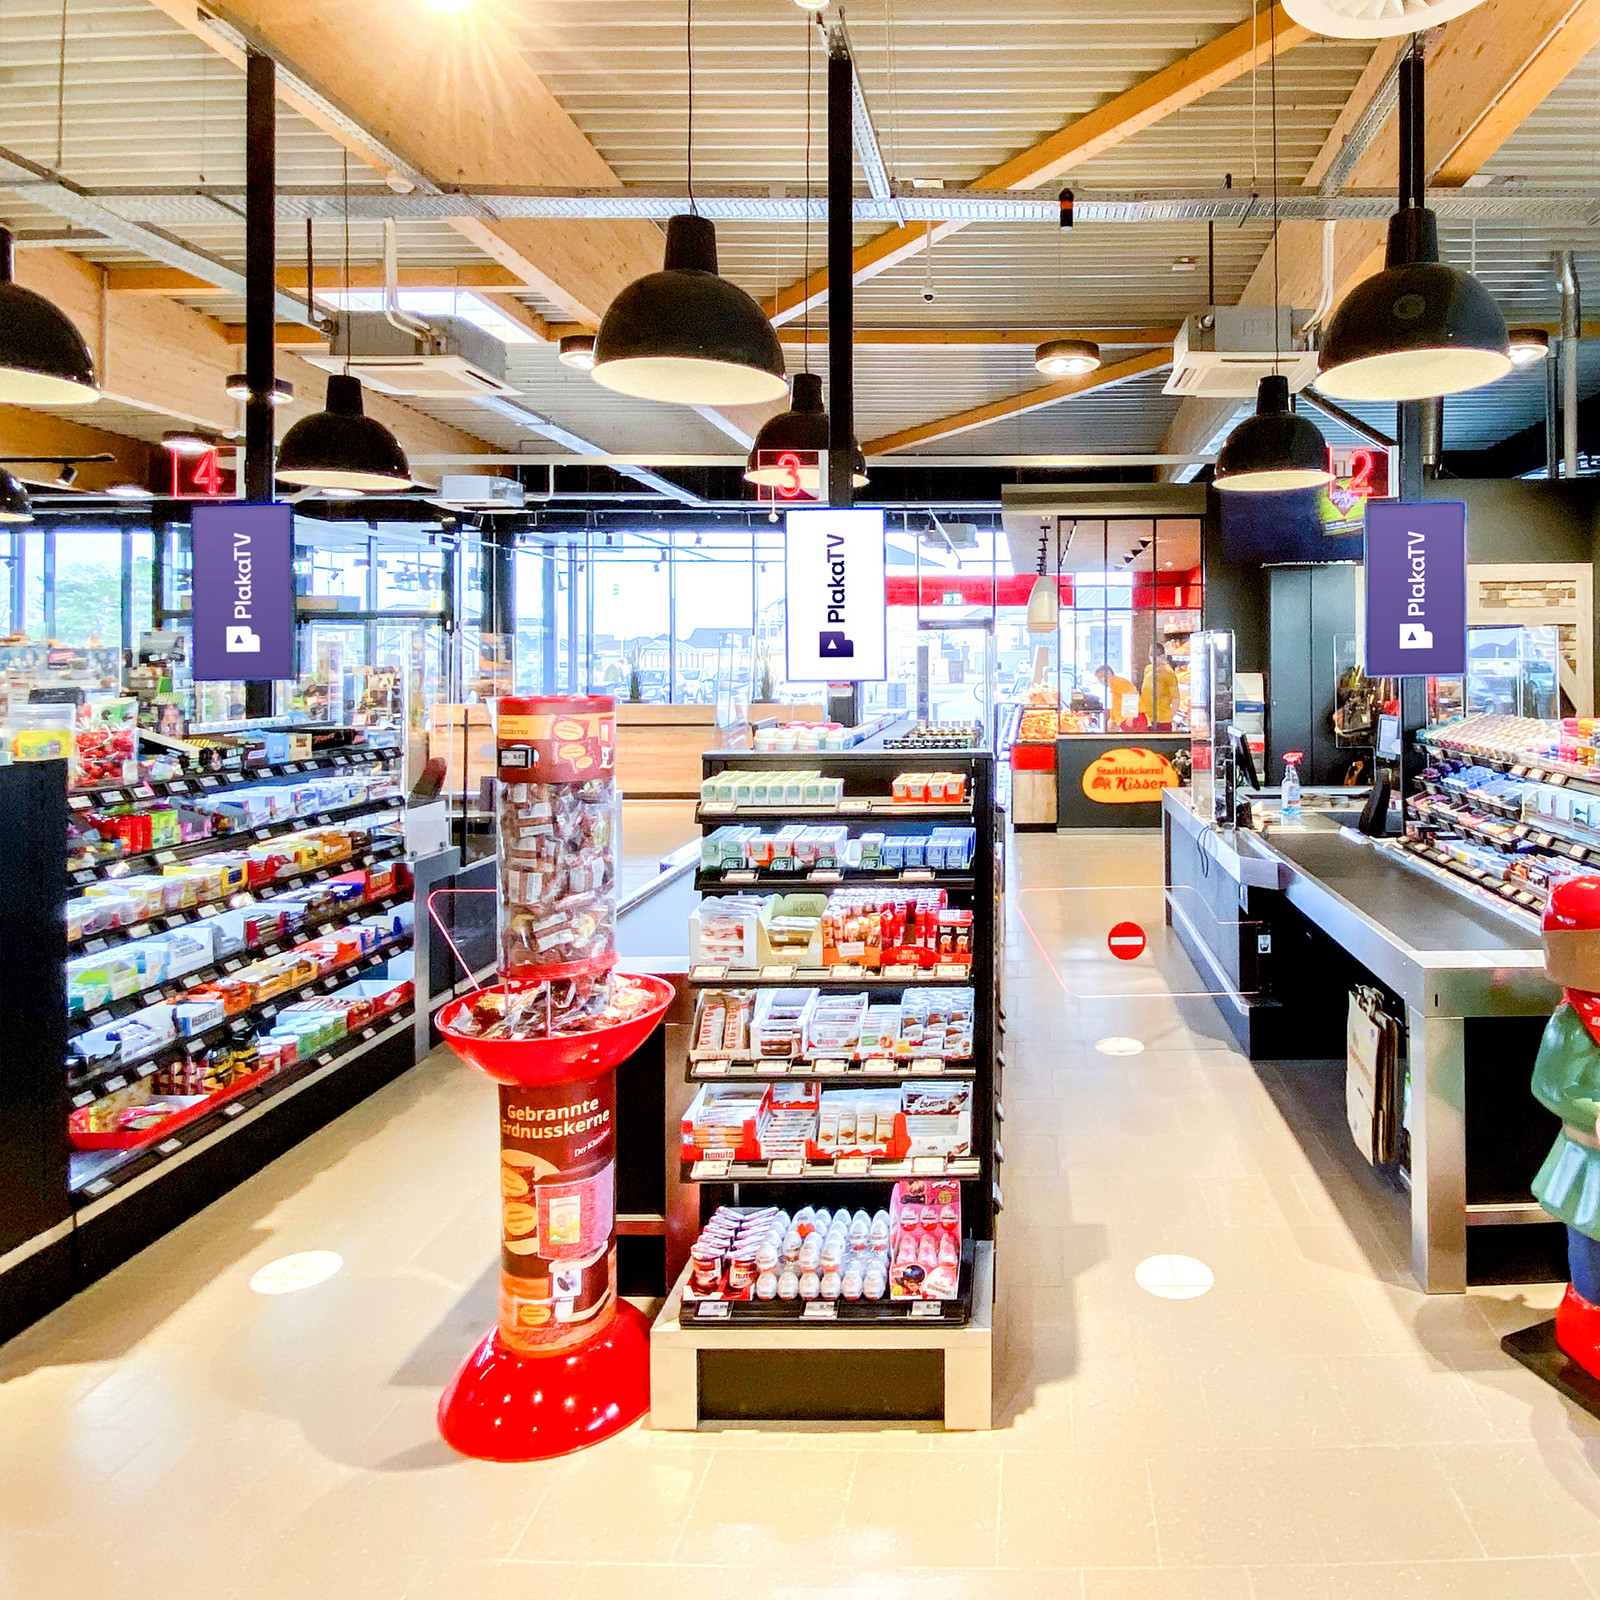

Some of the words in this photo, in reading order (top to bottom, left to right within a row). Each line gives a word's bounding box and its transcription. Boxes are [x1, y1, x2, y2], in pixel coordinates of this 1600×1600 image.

[193, 450, 224, 496] 4
[778, 453, 801, 497] 3
[1348, 449, 1374, 494] 2
[234, 532, 253, 620] PlakaTV
[827, 533, 847, 623] PlakaTV
[1407, 531, 1425, 616] PlakaTV
[1096, 766, 1164, 775] Stadtbäckerei
[507, 1098, 599, 1122] Gebrannte
